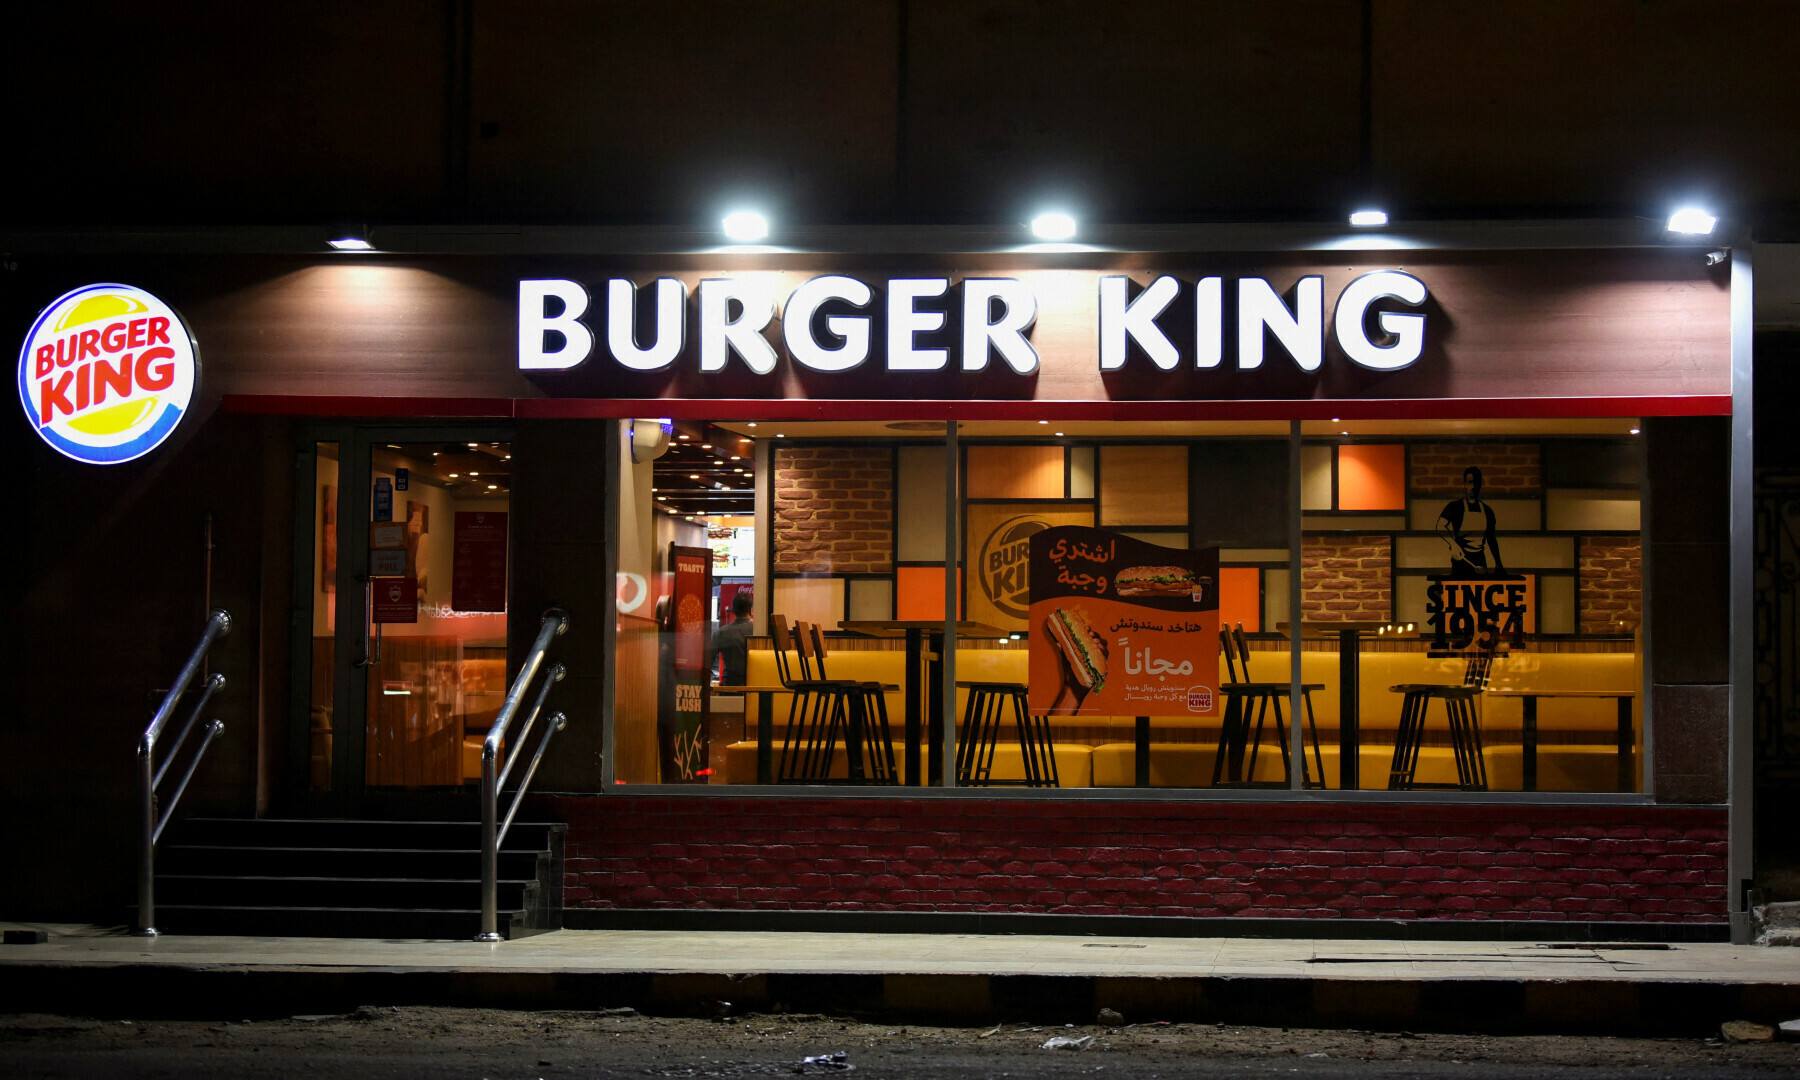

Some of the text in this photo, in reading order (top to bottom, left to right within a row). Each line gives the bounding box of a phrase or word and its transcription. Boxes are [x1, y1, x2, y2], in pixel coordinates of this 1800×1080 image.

[518, 270, 1428, 375] BURGER KING
[36, 317, 170, 379] BURGER
[41, 347, 175, 424] KING
[989, 542, 1030, 572] BUR
[1049, 539, 1115, 564] اشتري
[678, 563, 705, 574] TOASTY
[993, 561, 1030, 601] KI
[1057, 565, 1108, 594] وجبة
[1426, 584, 1527, 613] SINCE
[1110, 618, 1202, 633] هتاخد سندوتش
[1426, 611, 1527, 649] 1954
[675, 685, 702, 698] STAY
[675, 698, 702, 713] LUSH
[1188, 699, 1211, 707] KING
